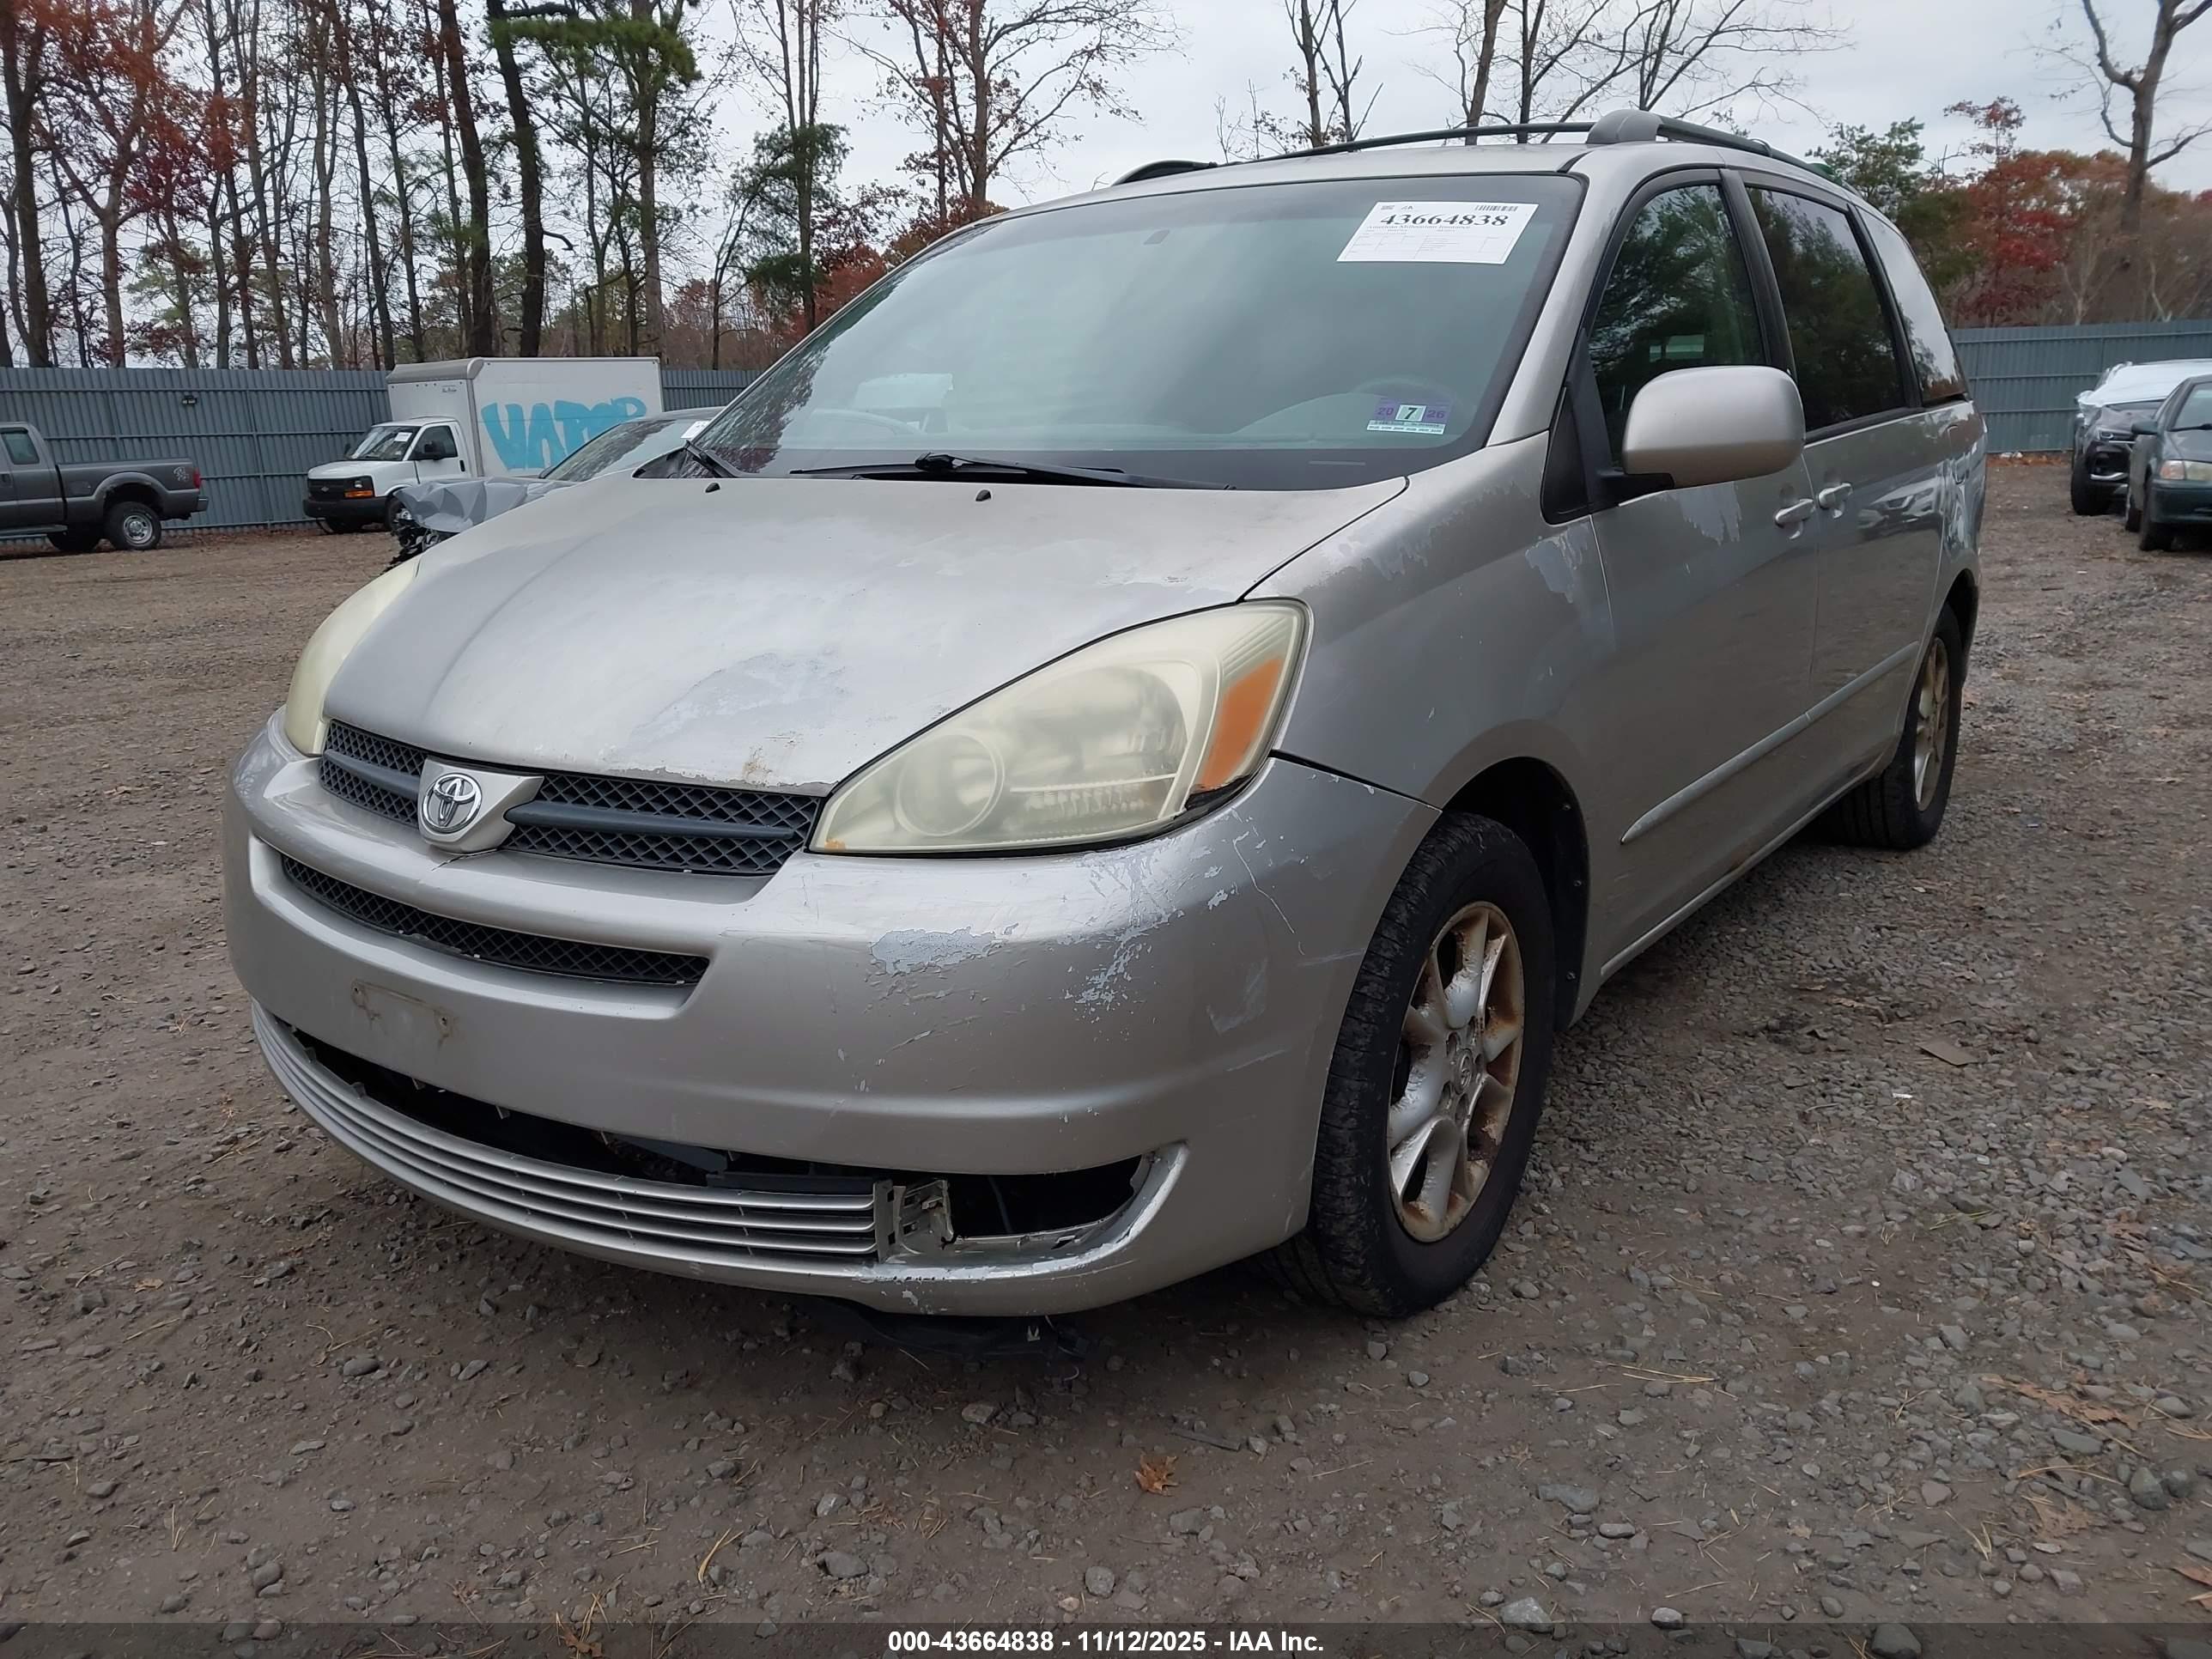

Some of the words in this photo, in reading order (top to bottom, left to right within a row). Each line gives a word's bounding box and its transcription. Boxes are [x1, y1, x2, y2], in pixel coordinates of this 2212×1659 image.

[1380, 213, 1510, 227] 43664838
[1377, 407, 1395, 416] 20
[1404, 407, 1417, 420] 7
[1426, 410, 1446, 419] 26
